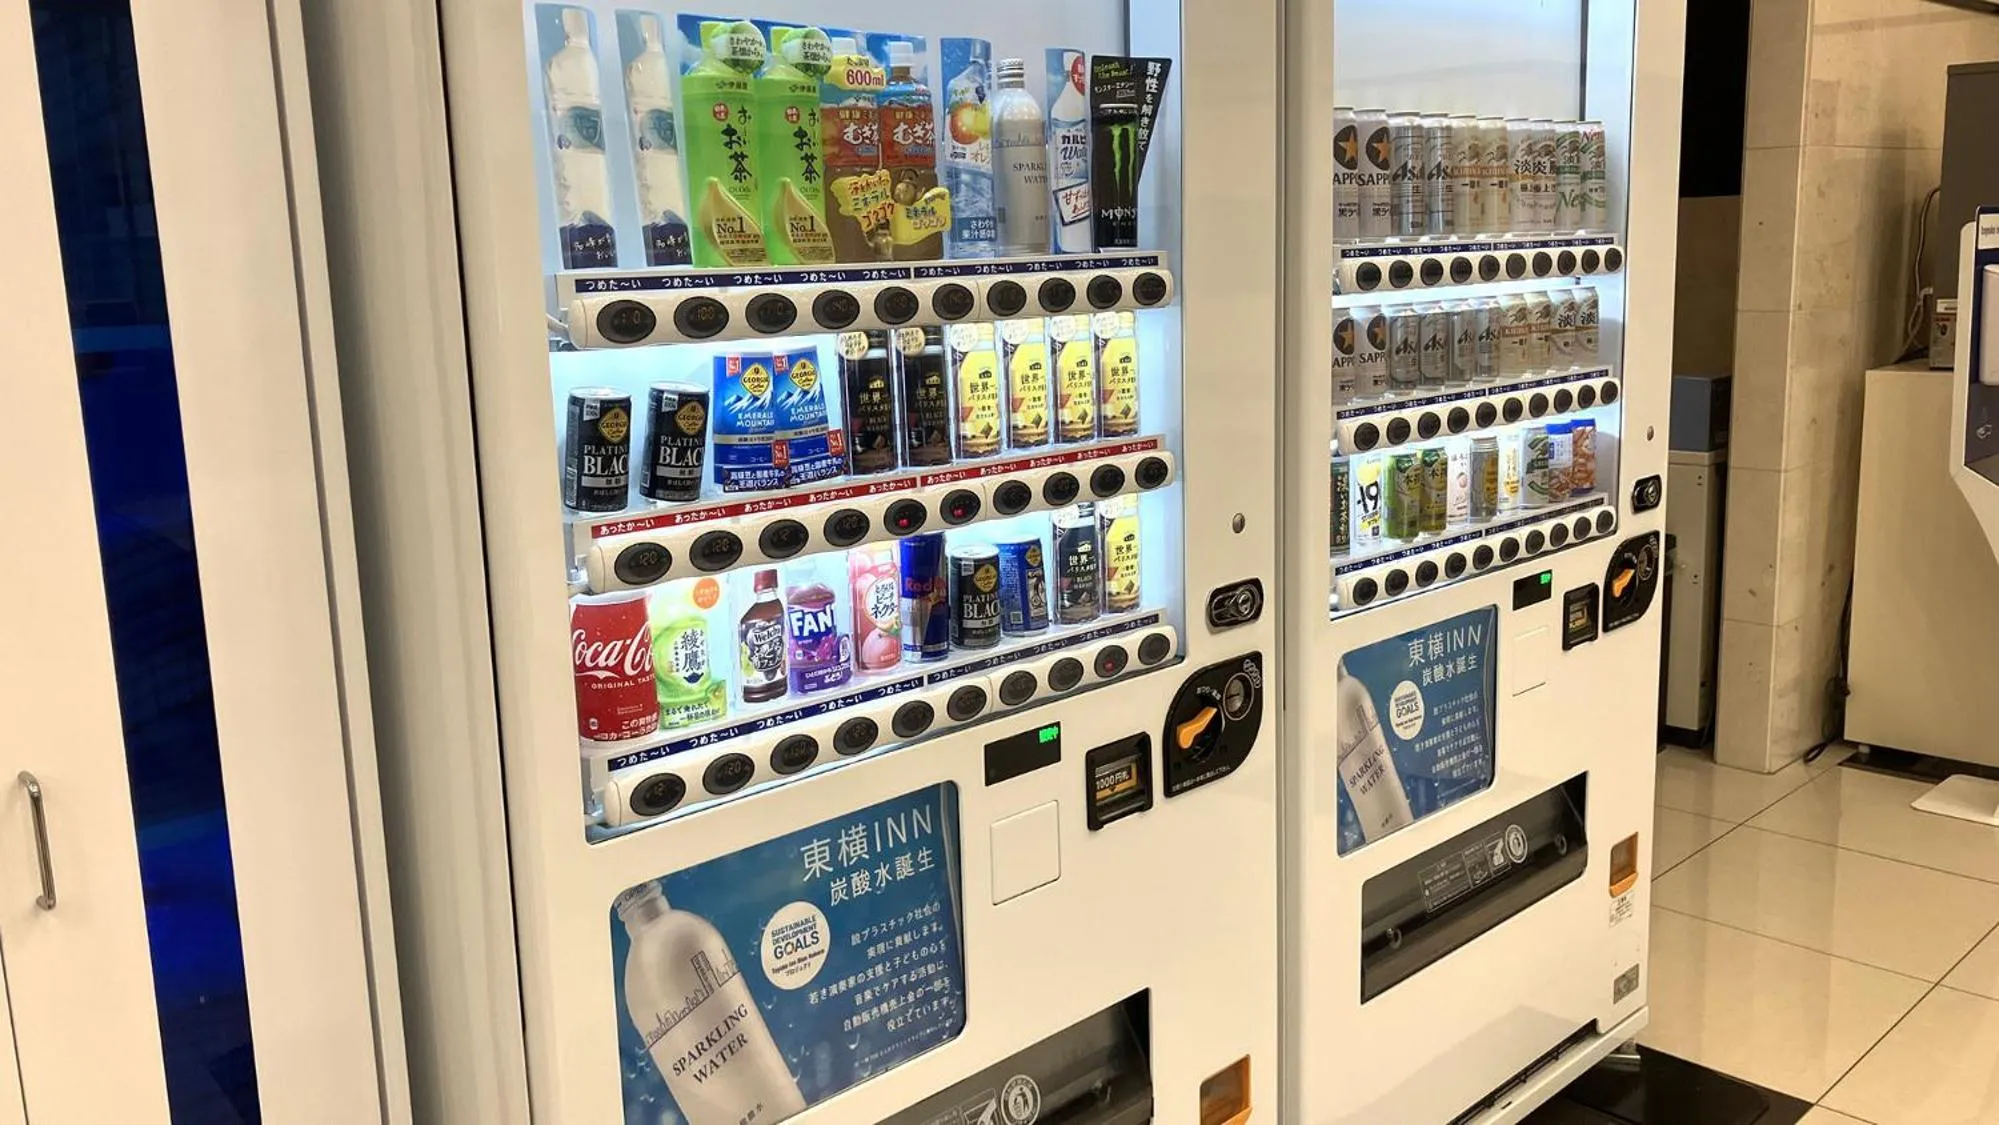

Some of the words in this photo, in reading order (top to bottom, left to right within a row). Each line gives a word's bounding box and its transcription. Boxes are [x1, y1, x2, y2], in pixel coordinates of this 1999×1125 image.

[846, 69, 884, 85] 600ml
[1138, 60, 1162, 150] 野性を解き放て
[720, 123, 752, 184] お茶
[793, 125, 820, 184] お茶
[601, 519, 655, 536] あったか～い
[674, 507, 726, 524] あったか～い
[744, 498, 792, 513] あったか～い
[808, 488, 854, 502] あったか～い
[868, 479, 912, 493] あったか～い
[680, 629, 702, 673] 綾鷹
[1407, 623, 1483, 668] 東横INN
[1422, 654, 1479, 687] 炭酸水誕生
[591, 681, 635, 690] ORIGINAL
[617, 745, 670, 766] つめた～い
[688, 727, 739, 747] つめた～い
[756, 709, 803, 729] つめた～い
[819, 694, 863, 712] つめた～い
[877, 679, 920, 697] つめた～い
[800, 804, 933, 883] 東横INN
[830, 846, 935, 907] 炭酸水誕生
[774, 930, 820, 960] GOALS
[672, 1003, 748, 1077] SPARKLING
[692, 1032, 748, 1085] WATER
